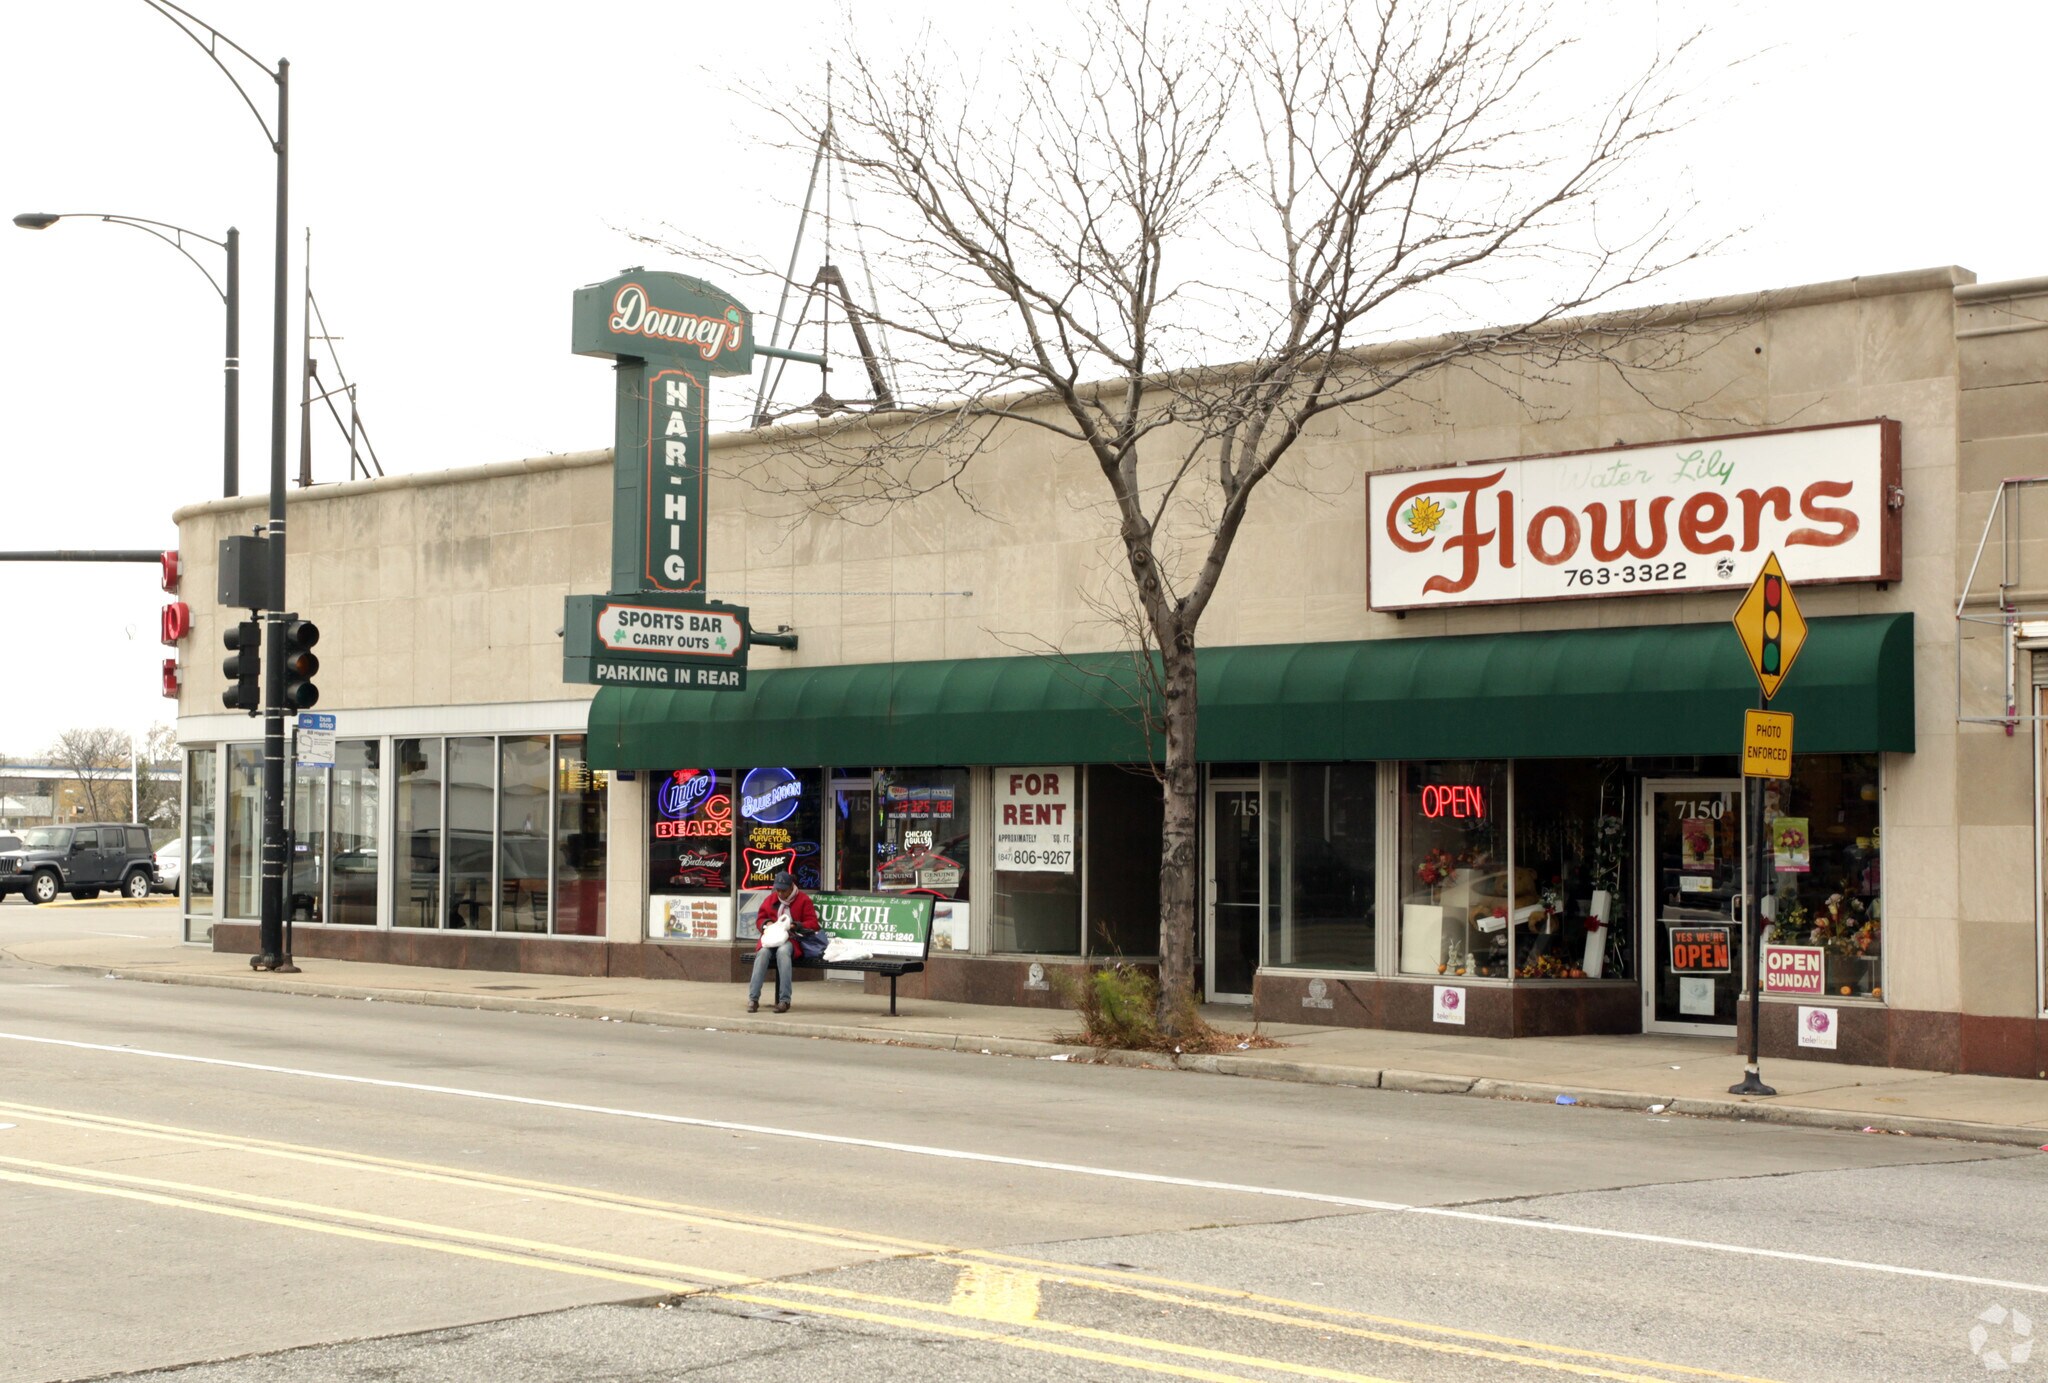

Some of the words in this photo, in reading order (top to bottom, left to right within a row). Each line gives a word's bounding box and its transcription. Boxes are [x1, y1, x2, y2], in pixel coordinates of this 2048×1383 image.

[611, 286, 741, 358] Downey's
[1556, 459, 1655, 491] Water
[1670, 449, 1736, 486] Lily
[664, 380, 688, 581] HAR-HIG
[1386, 467, 1860, 597] Flowers
[1564, 561, 1688, 588] 763-3322
[618, 610, 684, 631] SPORTS
[689, 616, 723, 634] BAR
[632, 632, 674, 647] CARRY
[677, 636, 710, 650] OUTS
[596, 664, 668, 683] PARKING
[674, 668, 691, 684] IN
[697, 670, 740, 686] REAR
[319, 715, 332, 723] bus
[319, 722, 334, 730] stop
[1756, 724, 1782, 738] PHOTO
[1747, 745, 1788, 761] ENFORCED
[1009, 773, 1059, 796] FOR
[1230, 799, 1261, 817] 715
[1422, 785, 1481, 818] OPEN
[1003, 803, 1067, 826] RENT
[1674, 800, 1725, 820] 7150
[656, 820, 733, 838] BEARS
[752, 827, 788, 836] CERTIFIED
[904, 830, 933, 838] CHICAGO
[749, 834, 792, 844] PURVEYORS
[769, 842, 784, 850] THE
[909, 837, 929, 845] BULLS
[998, 834, 1037, 843] APPROXIMATELY
[1063, 834, 1072, 843] FT.
[752, 856, 786, 874] Miller
[1013, 850, 1072, 865] 806-9267
[750, 873, 769, 881] HIGH
[883, 872, 914, 880] GENUINE
[924, 871, 956, 879] GENUINE
[818, 921, 855, 931] NERAL
[860, 923, 898, 932] HOME
[862, 931, 877, 940] 773
[879, 931, 915, 942] 631-1240
[1675, 932, 1693, 943] YES
[1696, 932, 1726, 943] WE'RE
[1674, 944, 1728, 969] OPEN
[1767, 952, 1820, 972] OPEN
[1768, 973, 1820, 988] SUNDAY
[1801, 1035, 1834, 1046] teleflora
